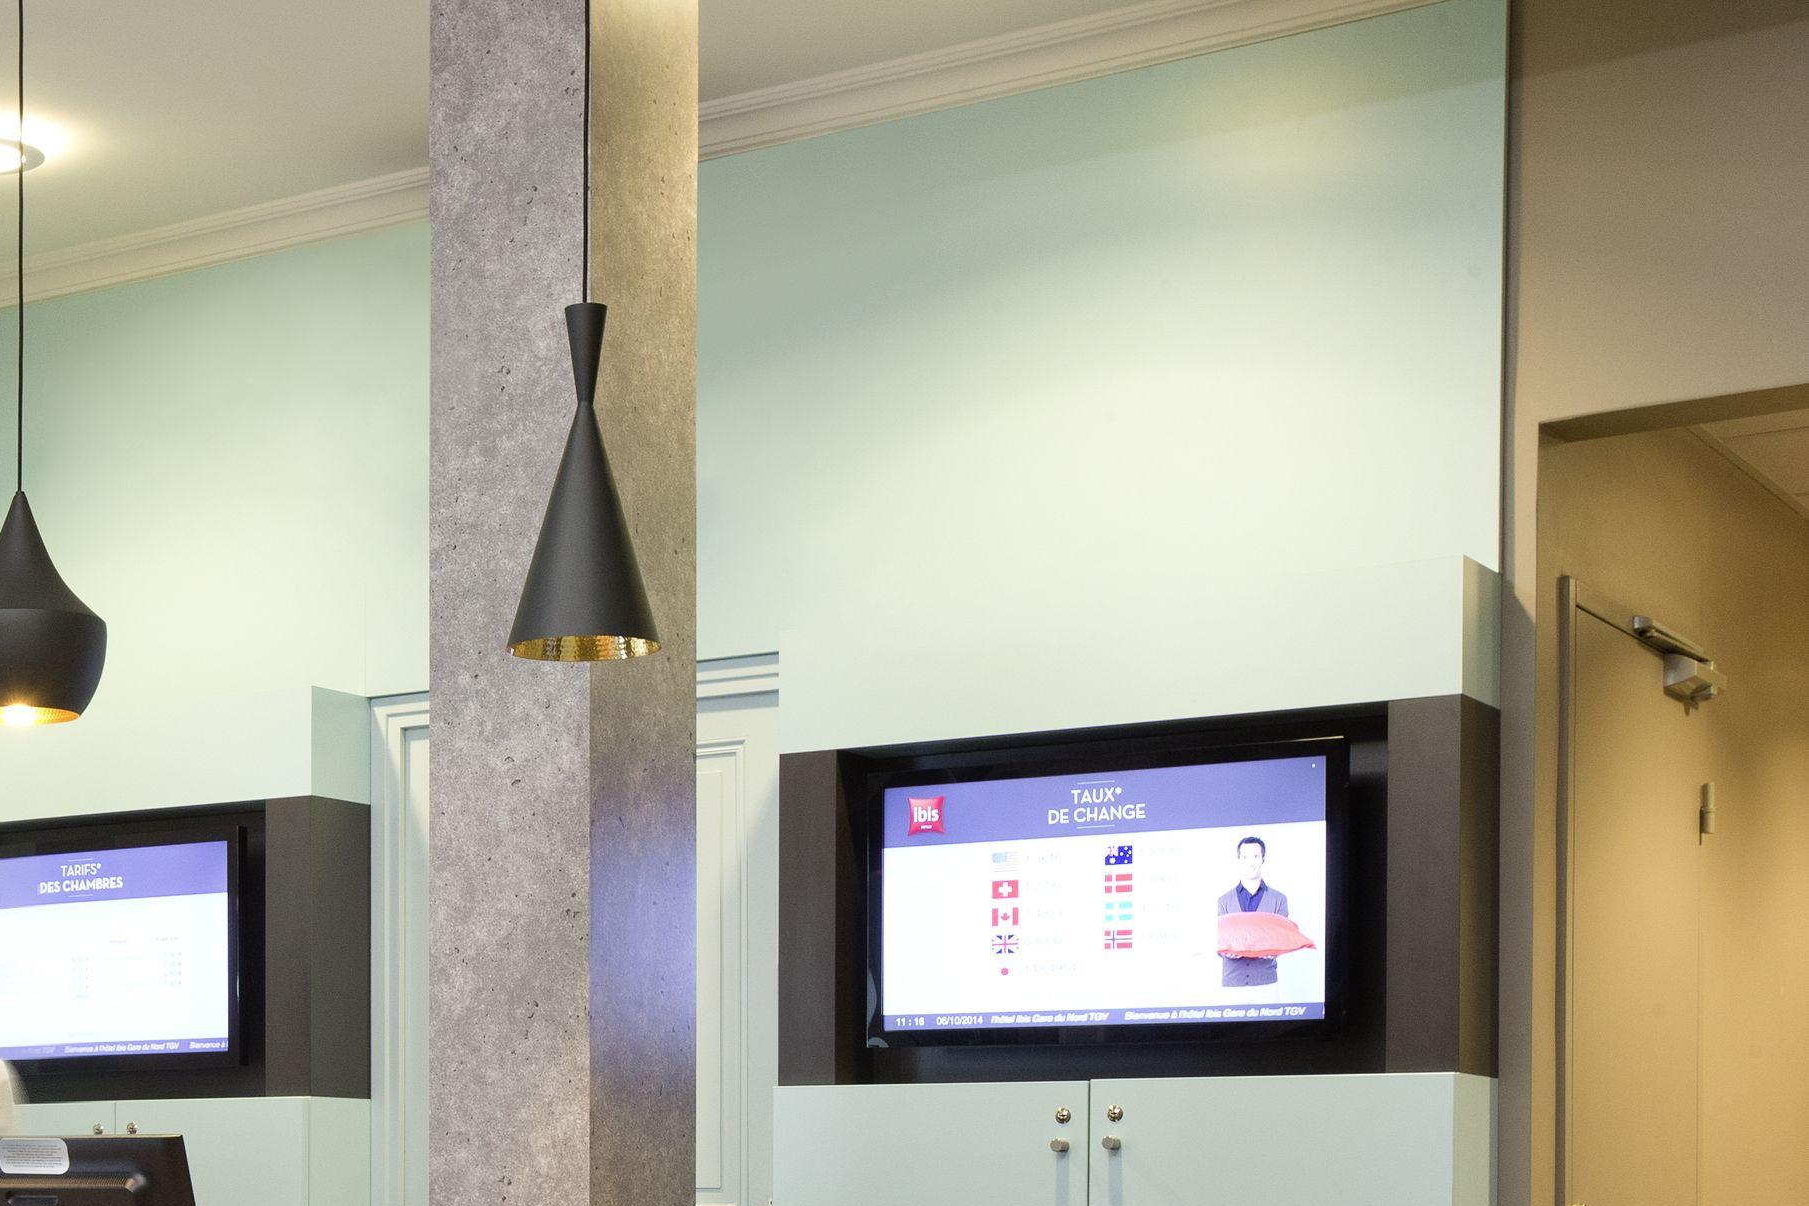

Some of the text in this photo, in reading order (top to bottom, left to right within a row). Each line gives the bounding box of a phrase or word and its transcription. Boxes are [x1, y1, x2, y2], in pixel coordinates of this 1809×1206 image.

[913, 806, 940, 823] ibis
[1047, 803, 1146, 825] DE CHANGE
[39, 876, 124, 895] DES CHAMBRES
[1032, 1014, 1054, 1023] Gare
[1054, 1013, 1066, 1022] du
[1066, 1013, 1088, 1022] Nord
[1088, 1012, 1110, 1021] TGV
[1222, 1009, 1245, 1018] Gare
[1246, 1008, 1259, 1017] du
[1260, 1007, 1283, 1017] Nord
[1284, 1006, 1307, 1016] TGV
[895, 1017, 906, 1027] 11
